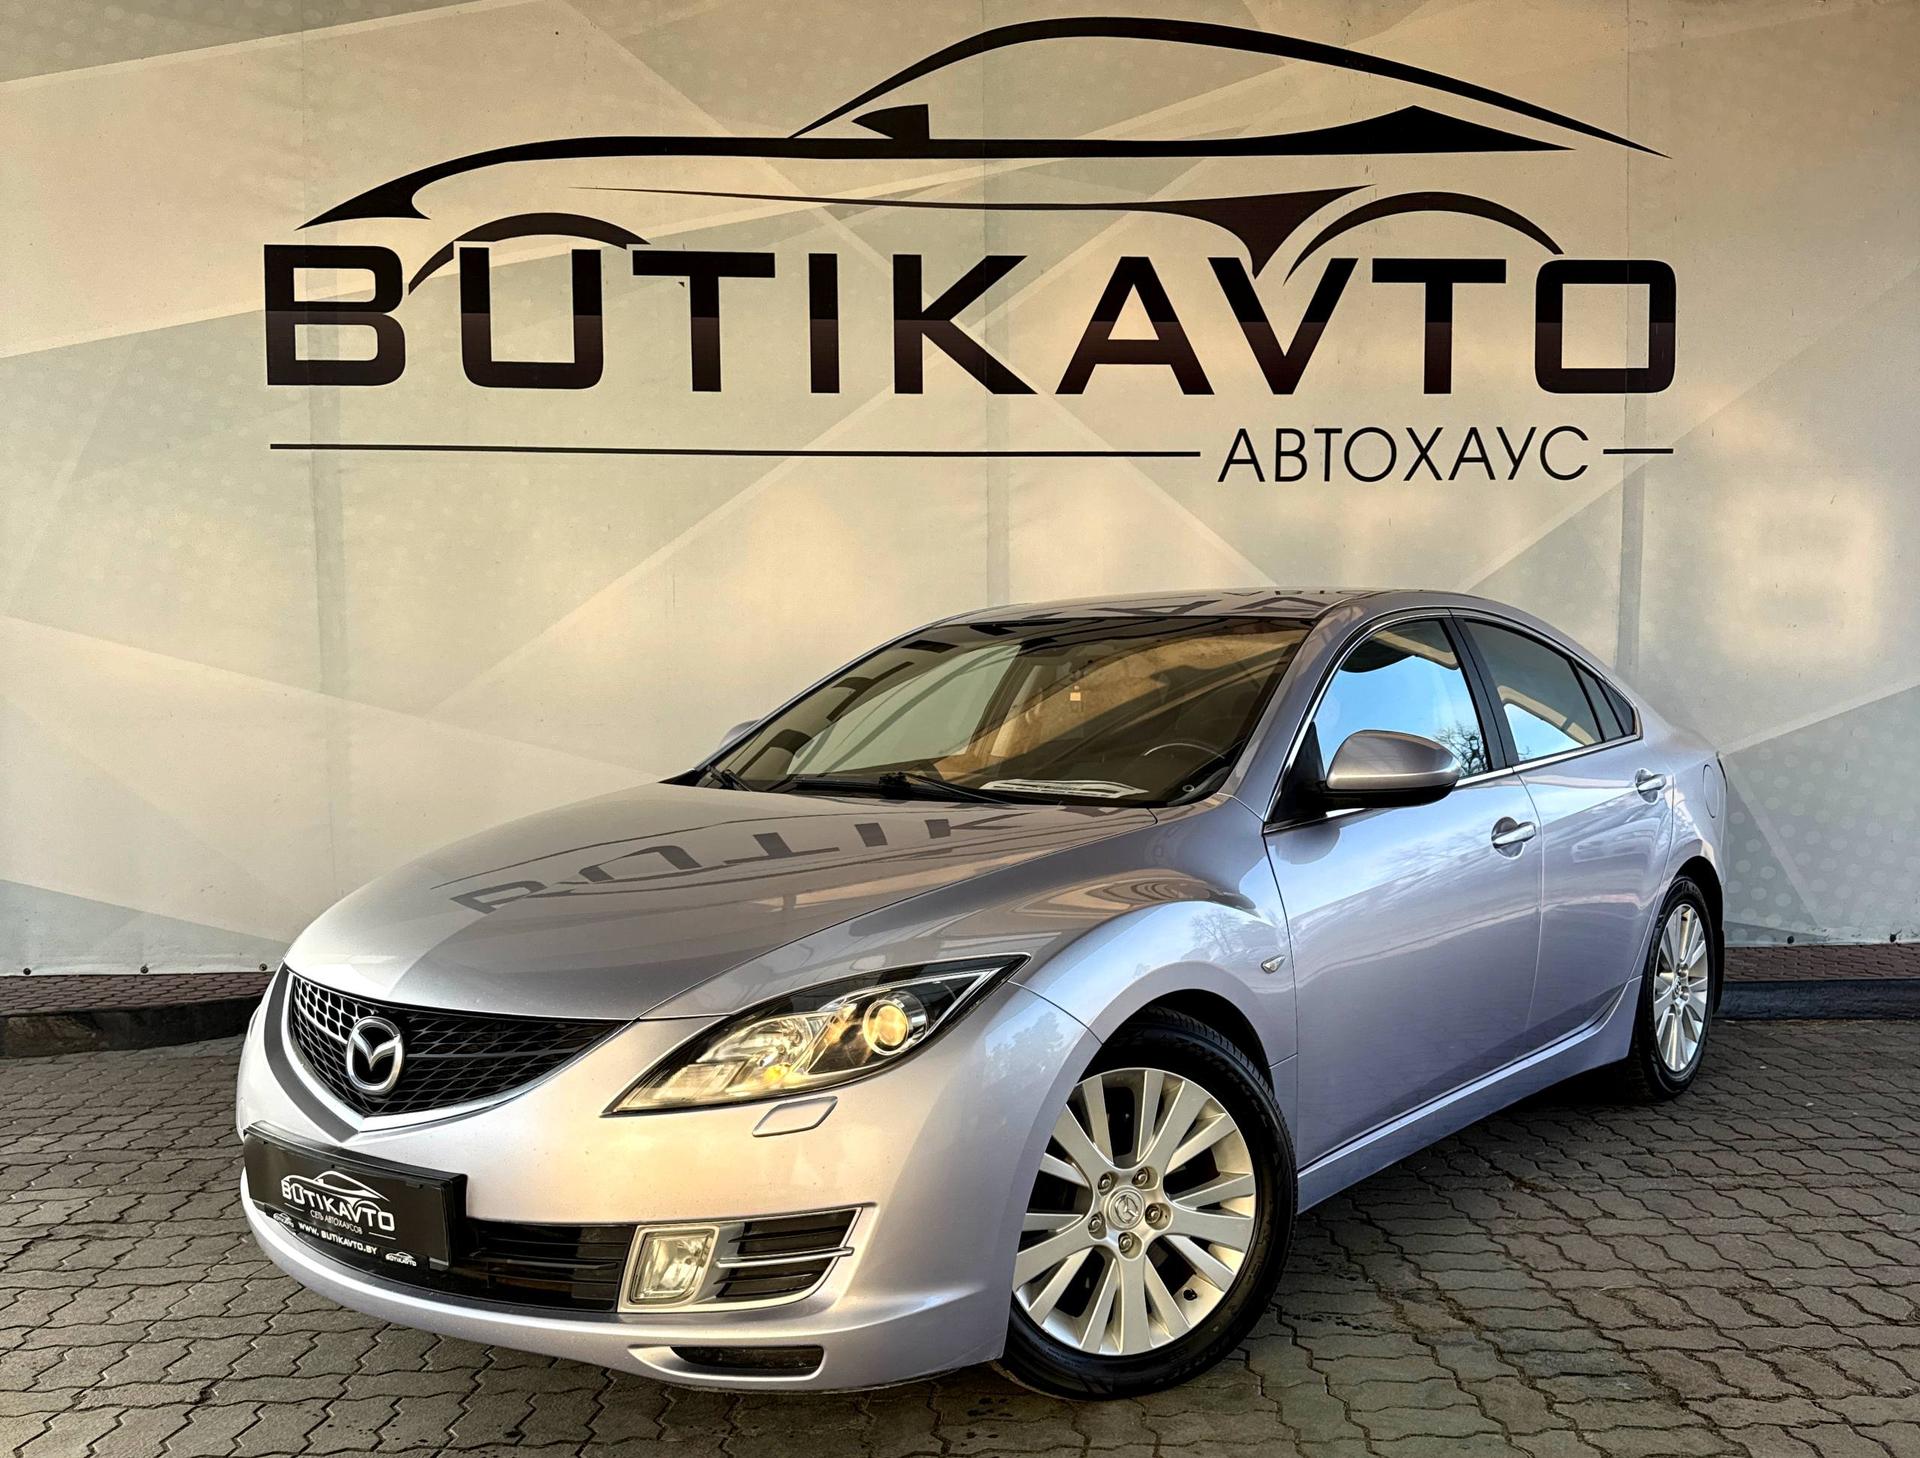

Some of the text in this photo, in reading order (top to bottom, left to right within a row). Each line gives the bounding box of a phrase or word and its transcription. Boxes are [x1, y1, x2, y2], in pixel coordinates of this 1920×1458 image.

[264, 244, 1676, 395] BUTIKAVTO
[1218, 426, 1589, 482] АВТОХАУС
[281, 1179, 395, 1232] BUTIKAVTO
